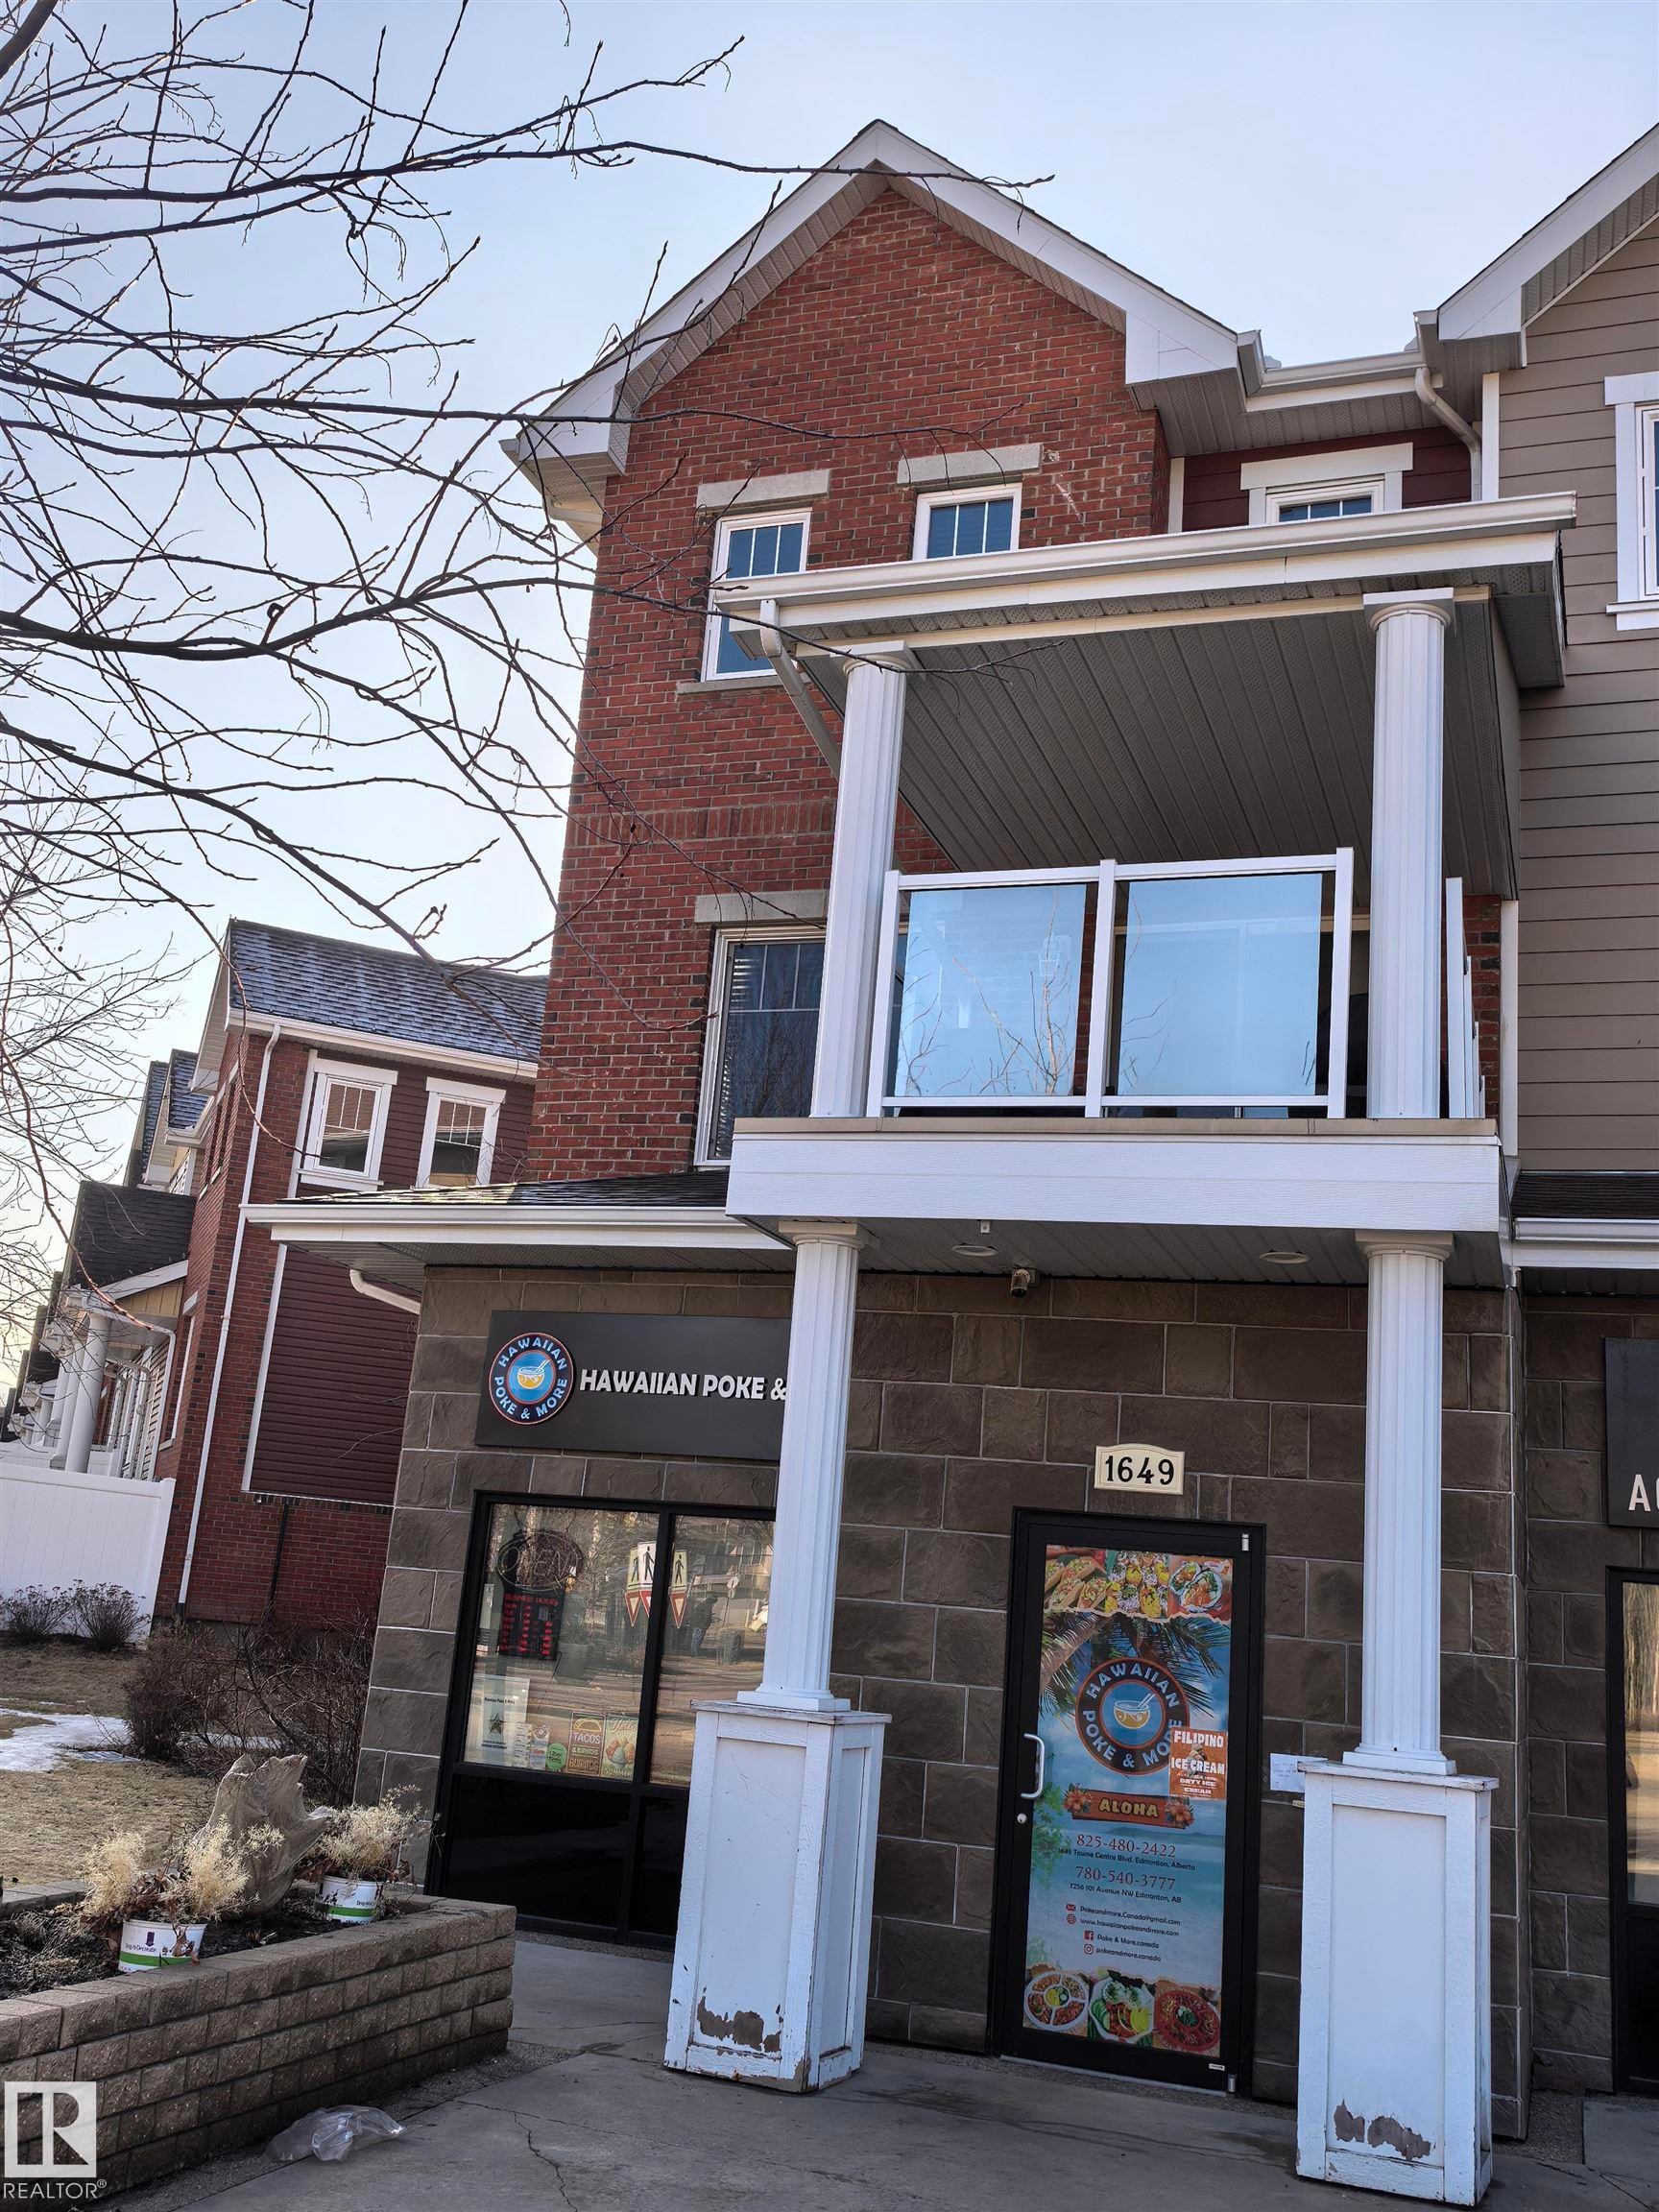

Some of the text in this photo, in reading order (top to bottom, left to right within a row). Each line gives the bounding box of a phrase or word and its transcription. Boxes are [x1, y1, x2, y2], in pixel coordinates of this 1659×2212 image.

[498, 1336, 567, 1370] HAWAIIAN
[579, 1368, 787, 1401] HAWAIIAN POKE &
[494, 1376, 567, 1419] POKE & MORE
[1104, 1455, 1175, 1485] 1649
[1085, 1662, 1180, 1708] HAWAIIAN
[572, 1732, 601, 1744] TACOS
[1083, 1710, 1117, 1761] POKE
[1122, 1753, 1135, 1767] &
[1173, 1730, 1224, 1748] FILIPINO
[1171, 1757, 1225, 1775] ICE CREAM
[1098, 1798, 1159, 1817] ALOHA
[1076, 1834, 1176, 1858] 825-480-2422
[1073, 1848, 1094, 1858] Towne
[1094, 1852, 1117, 1862] Centre
[1170, 1862, 1196, 1871] Alberta
[1074, 1865, 1176, 1890] 780-540-3777
[1095, 1887, 1120, 1895] Avenue
